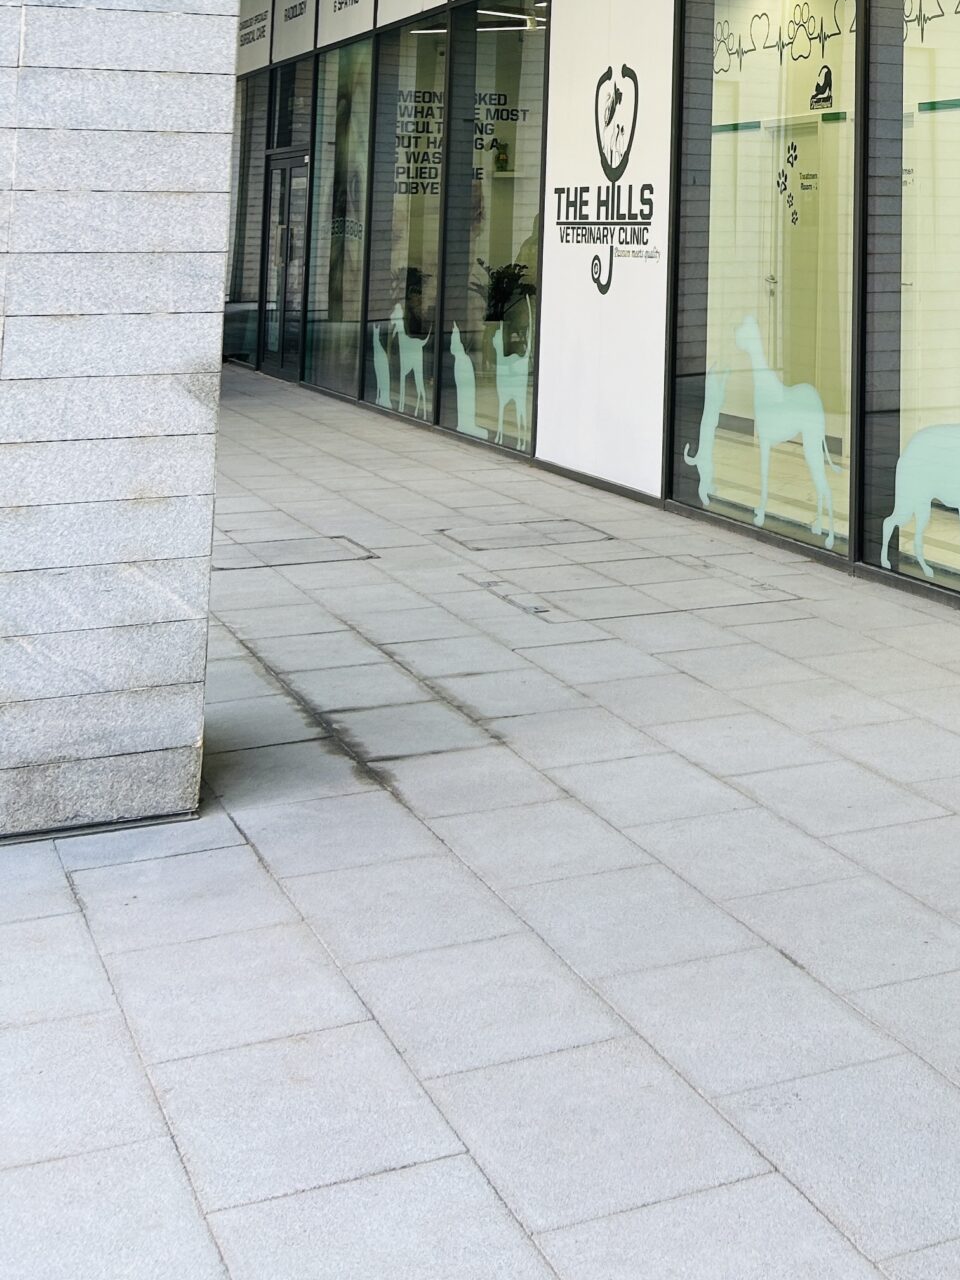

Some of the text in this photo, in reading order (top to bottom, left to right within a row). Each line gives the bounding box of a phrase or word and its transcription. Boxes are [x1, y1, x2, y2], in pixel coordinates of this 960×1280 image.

[486, 108, 530, 122] MOST
[554, 183, 654, 221] THE HILLS
[559, 226, 649, 246] VETERINARY CLINIC
